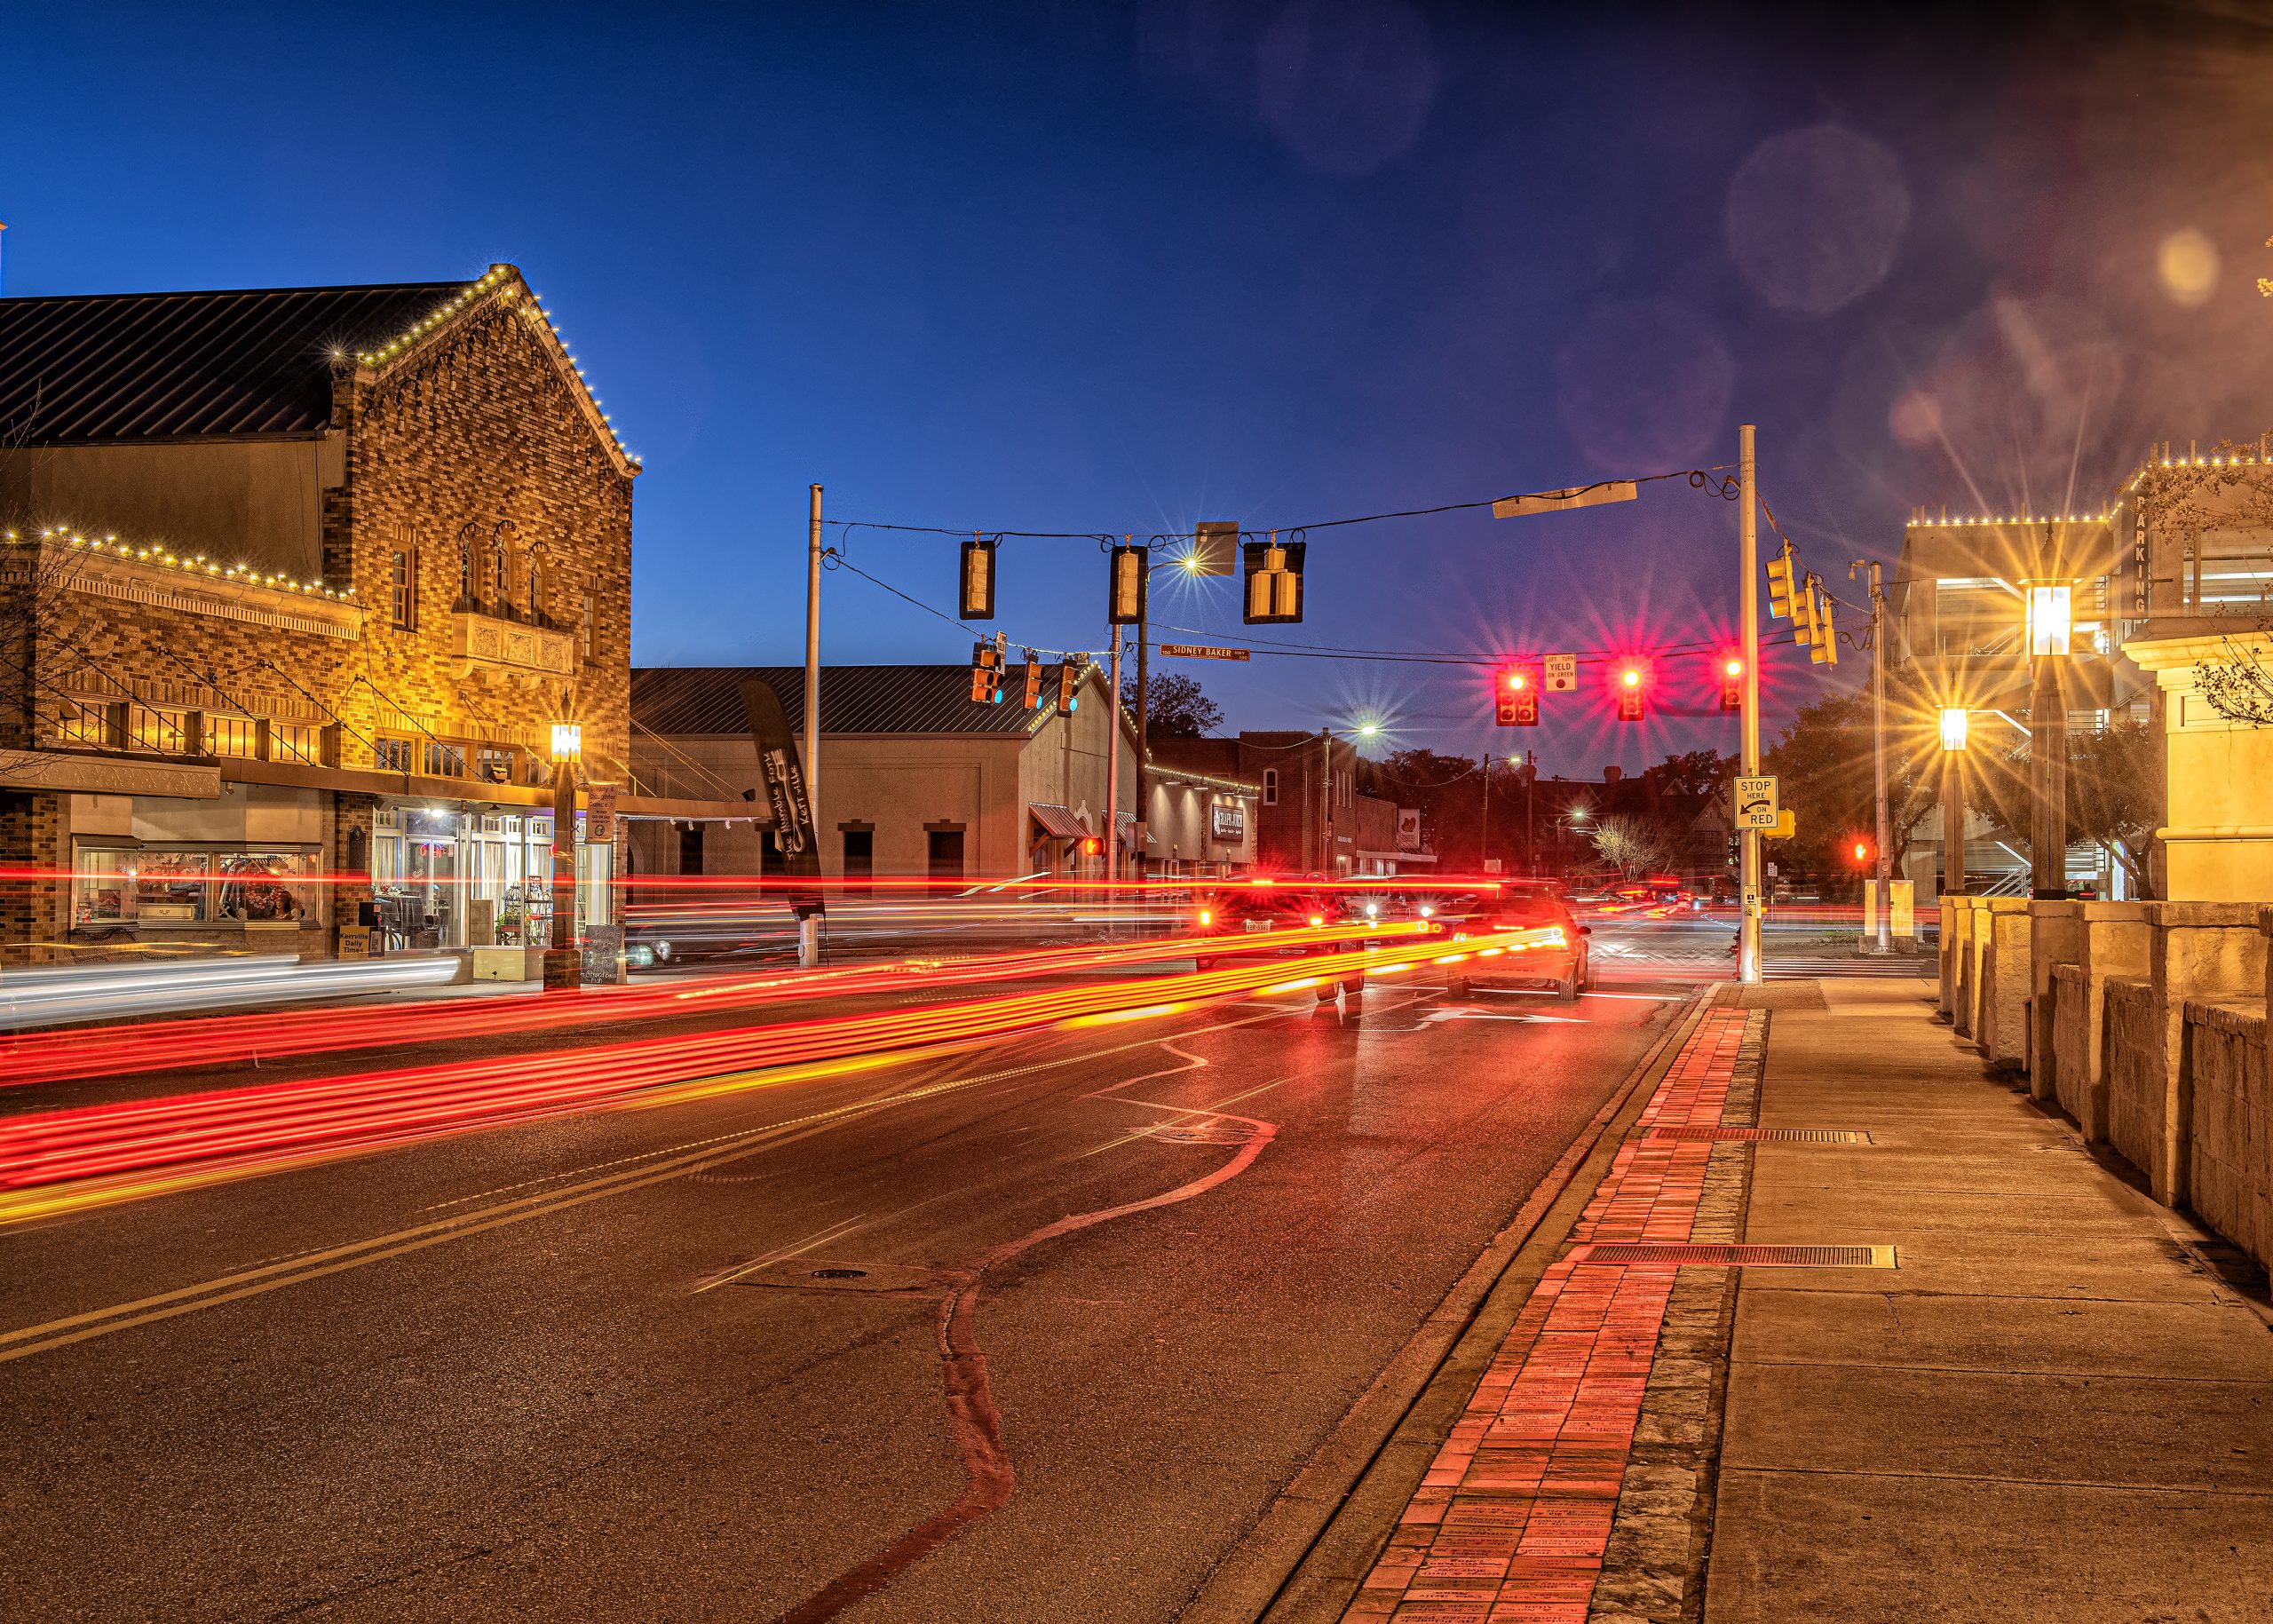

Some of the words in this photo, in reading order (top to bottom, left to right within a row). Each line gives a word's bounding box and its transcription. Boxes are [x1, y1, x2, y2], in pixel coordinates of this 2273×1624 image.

[2135, 495, 2145, 613] PARKING
[1173, 646, 1203, 654] SIDNEY
[1206, 648, 1231, 657] BAKER
[1741, 781, 1770, 791] STOP
[1751, 814, 1773, 824] RED
